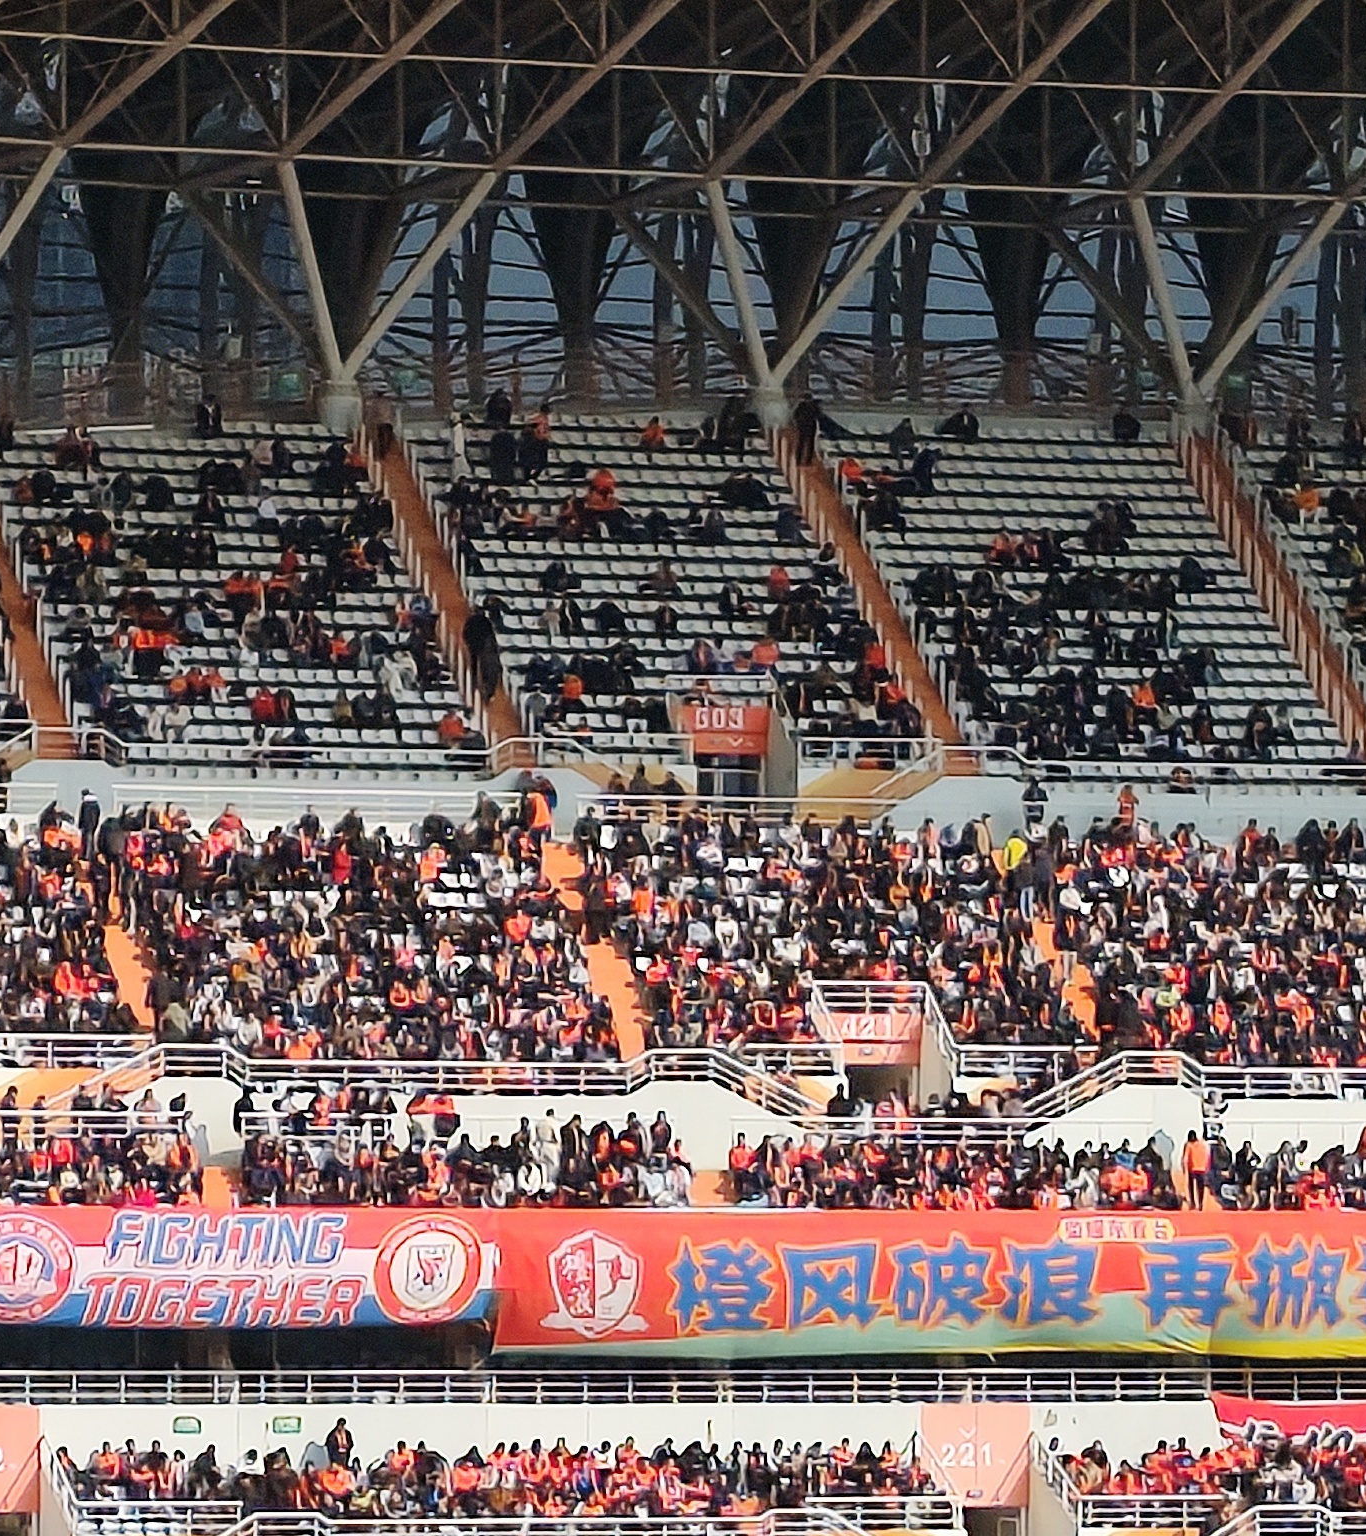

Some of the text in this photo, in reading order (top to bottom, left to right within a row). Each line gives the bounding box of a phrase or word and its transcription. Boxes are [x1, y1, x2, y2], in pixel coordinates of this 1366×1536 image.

[105, 1210, 349, 1268] FIGHTING
[81, 1272, 367, 1328] TOGETHER
[940, 1441, 993, 1468] 221
